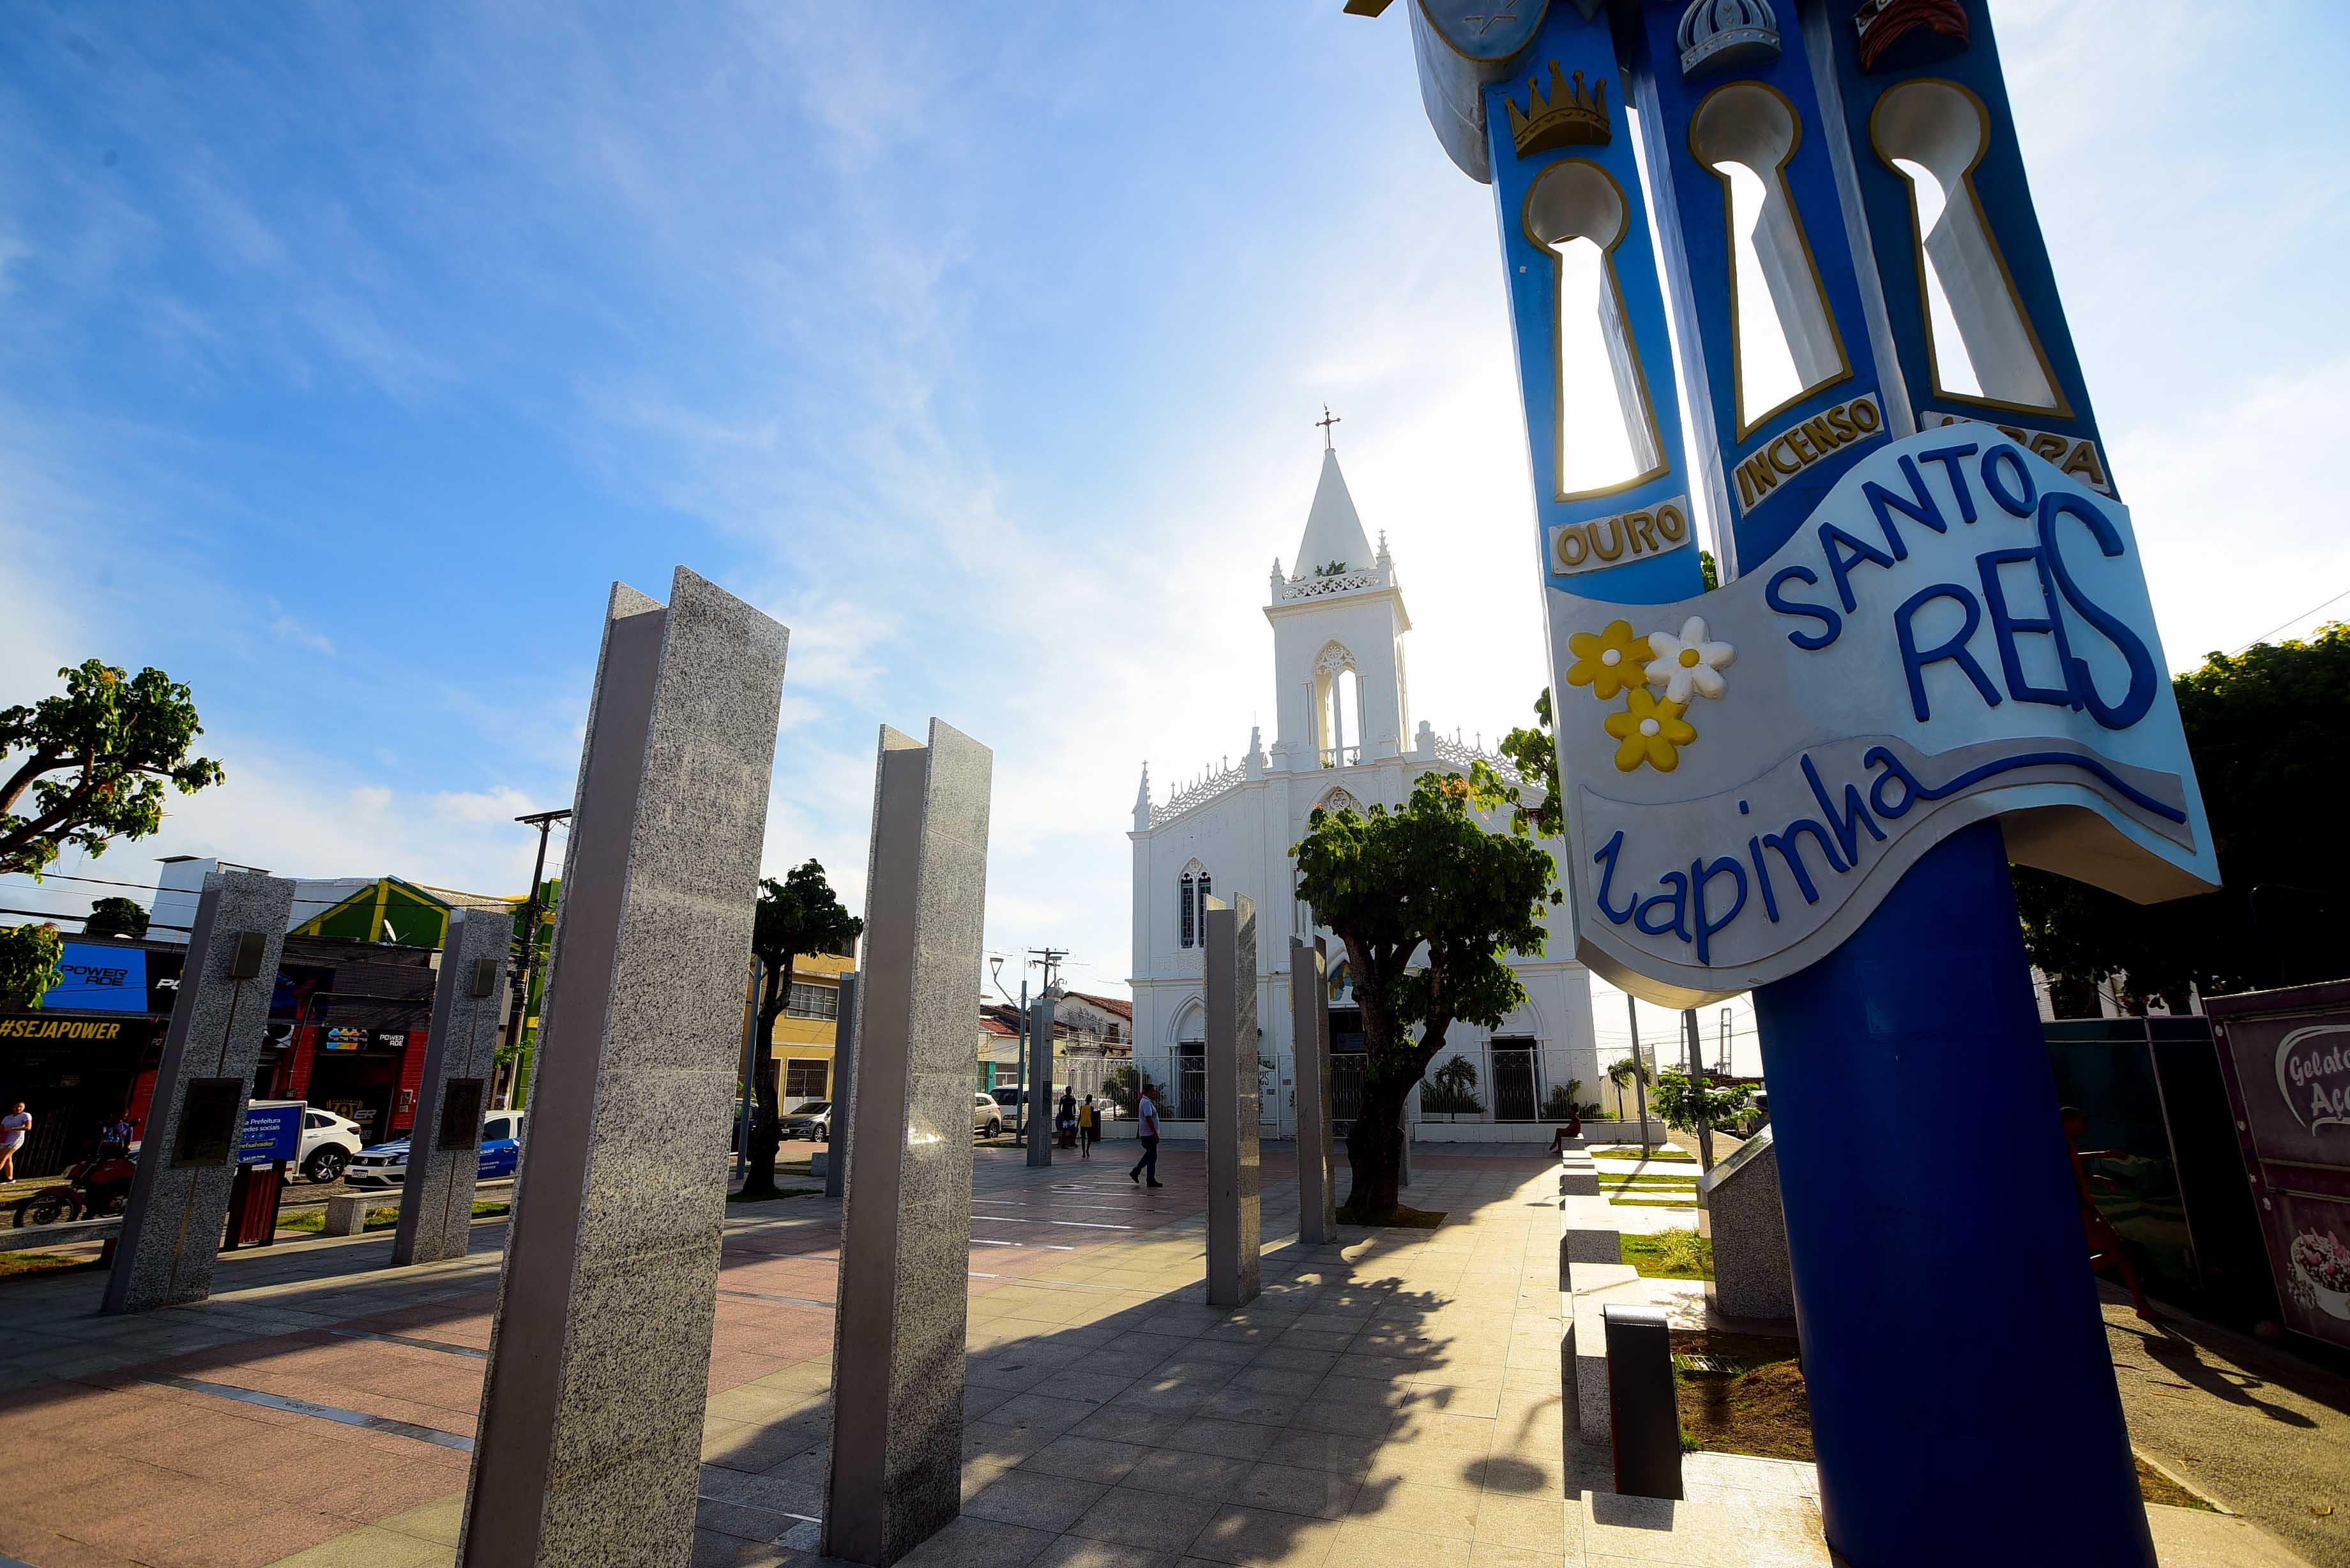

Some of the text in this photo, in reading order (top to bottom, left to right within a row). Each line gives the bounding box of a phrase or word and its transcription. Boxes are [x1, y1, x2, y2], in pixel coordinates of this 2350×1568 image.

[1736, 396, 1881, 506] INCENSO
[1557, 503, 1686, 567] OURO
[1764, 442, 2037, 650] SANTO
[1893, 491, 2158, 731] REIS
[61, 964, 128, 978] POWER
[85, 976, 124, 986] ADE
[0, 1020, 121, 1039] #SEJAPOWER
